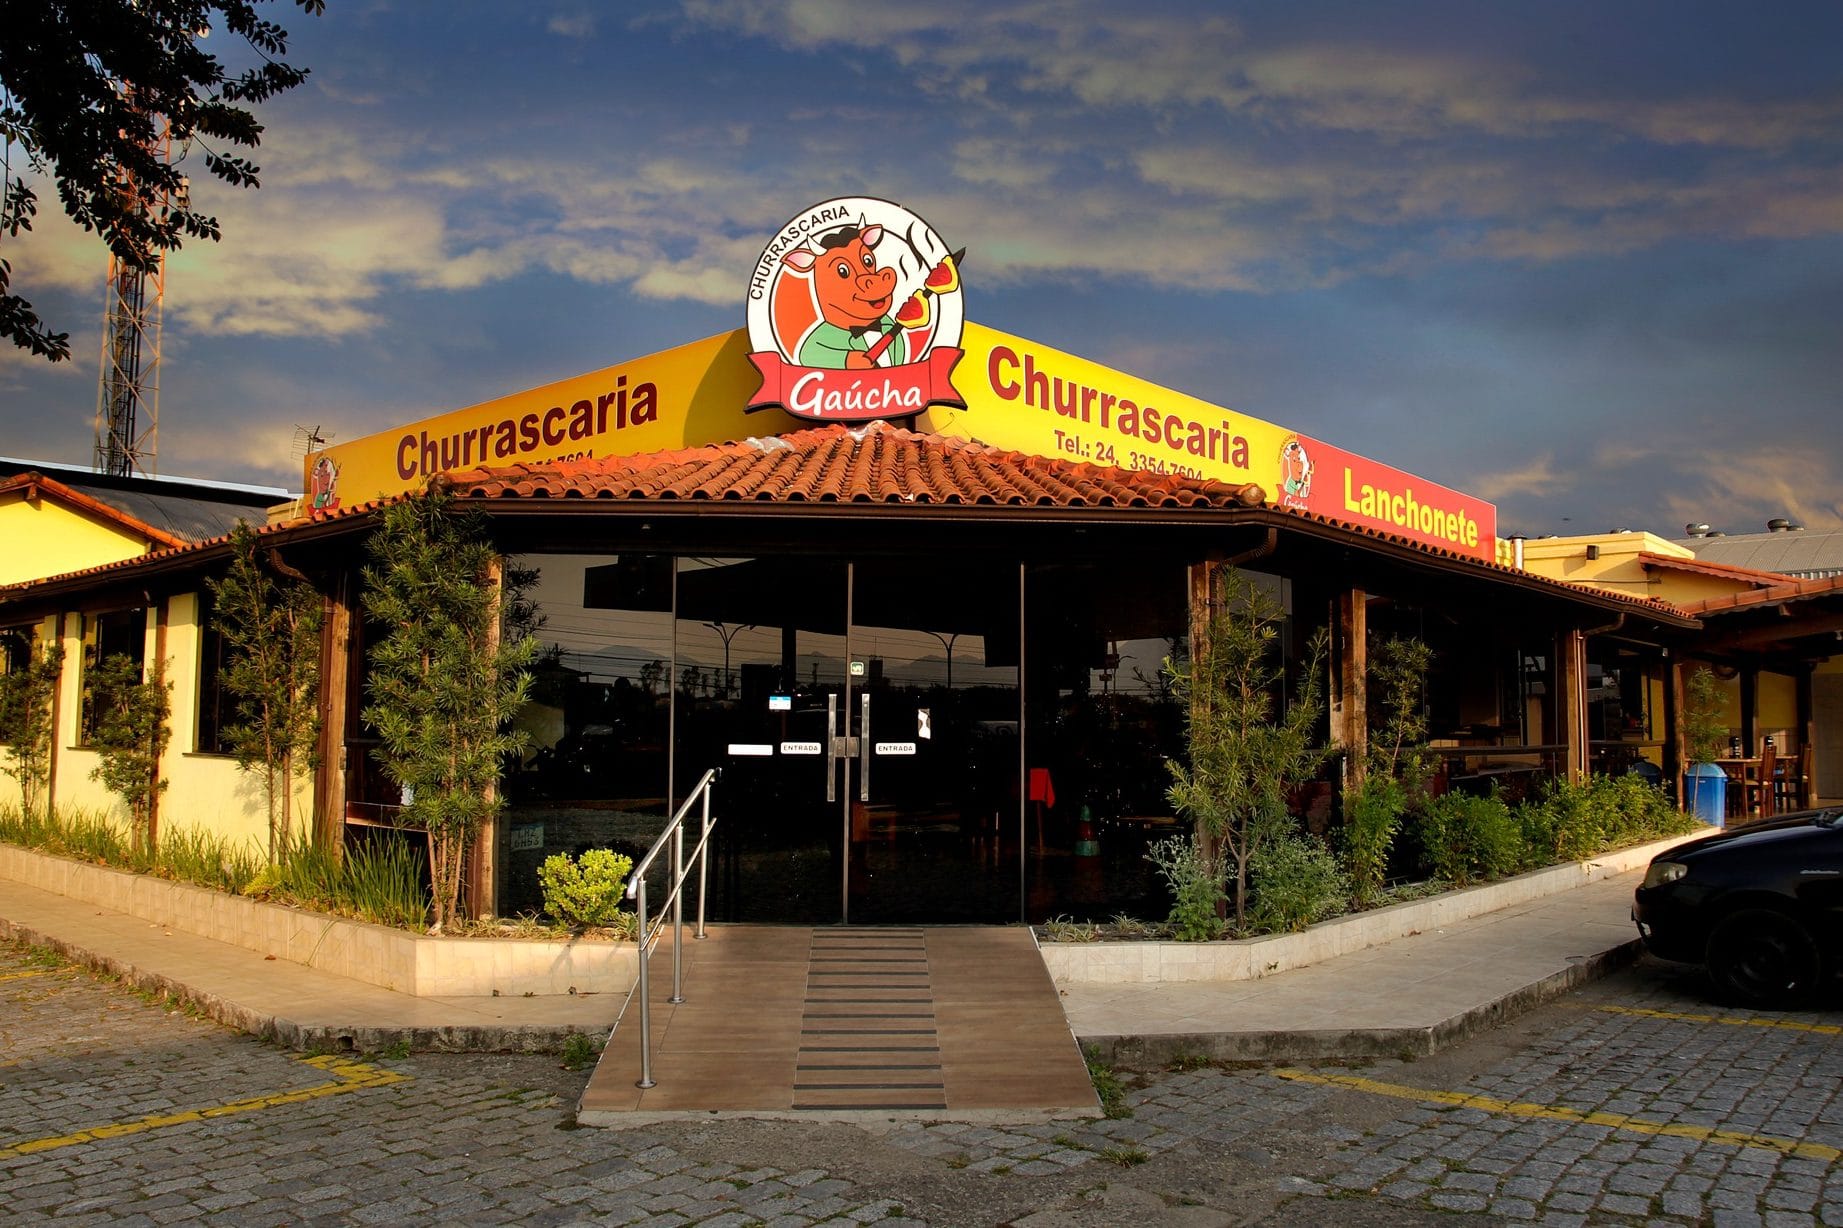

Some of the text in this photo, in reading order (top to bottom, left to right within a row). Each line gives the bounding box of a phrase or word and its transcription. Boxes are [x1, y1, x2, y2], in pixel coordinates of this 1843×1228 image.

[750, 205, 850, 300] CHURRASCARIA
[396, 374, 658, 481] Churrascaria
[789, 371, 922, 416] Gaúcha
[988, 345, 1250, 470] Churrascaria
[1054, 429, 1090, 458] Tel.:
[1344, 467, 1479, 548] Lanchonete
[783, 744, 819, 752] ENTRADA
